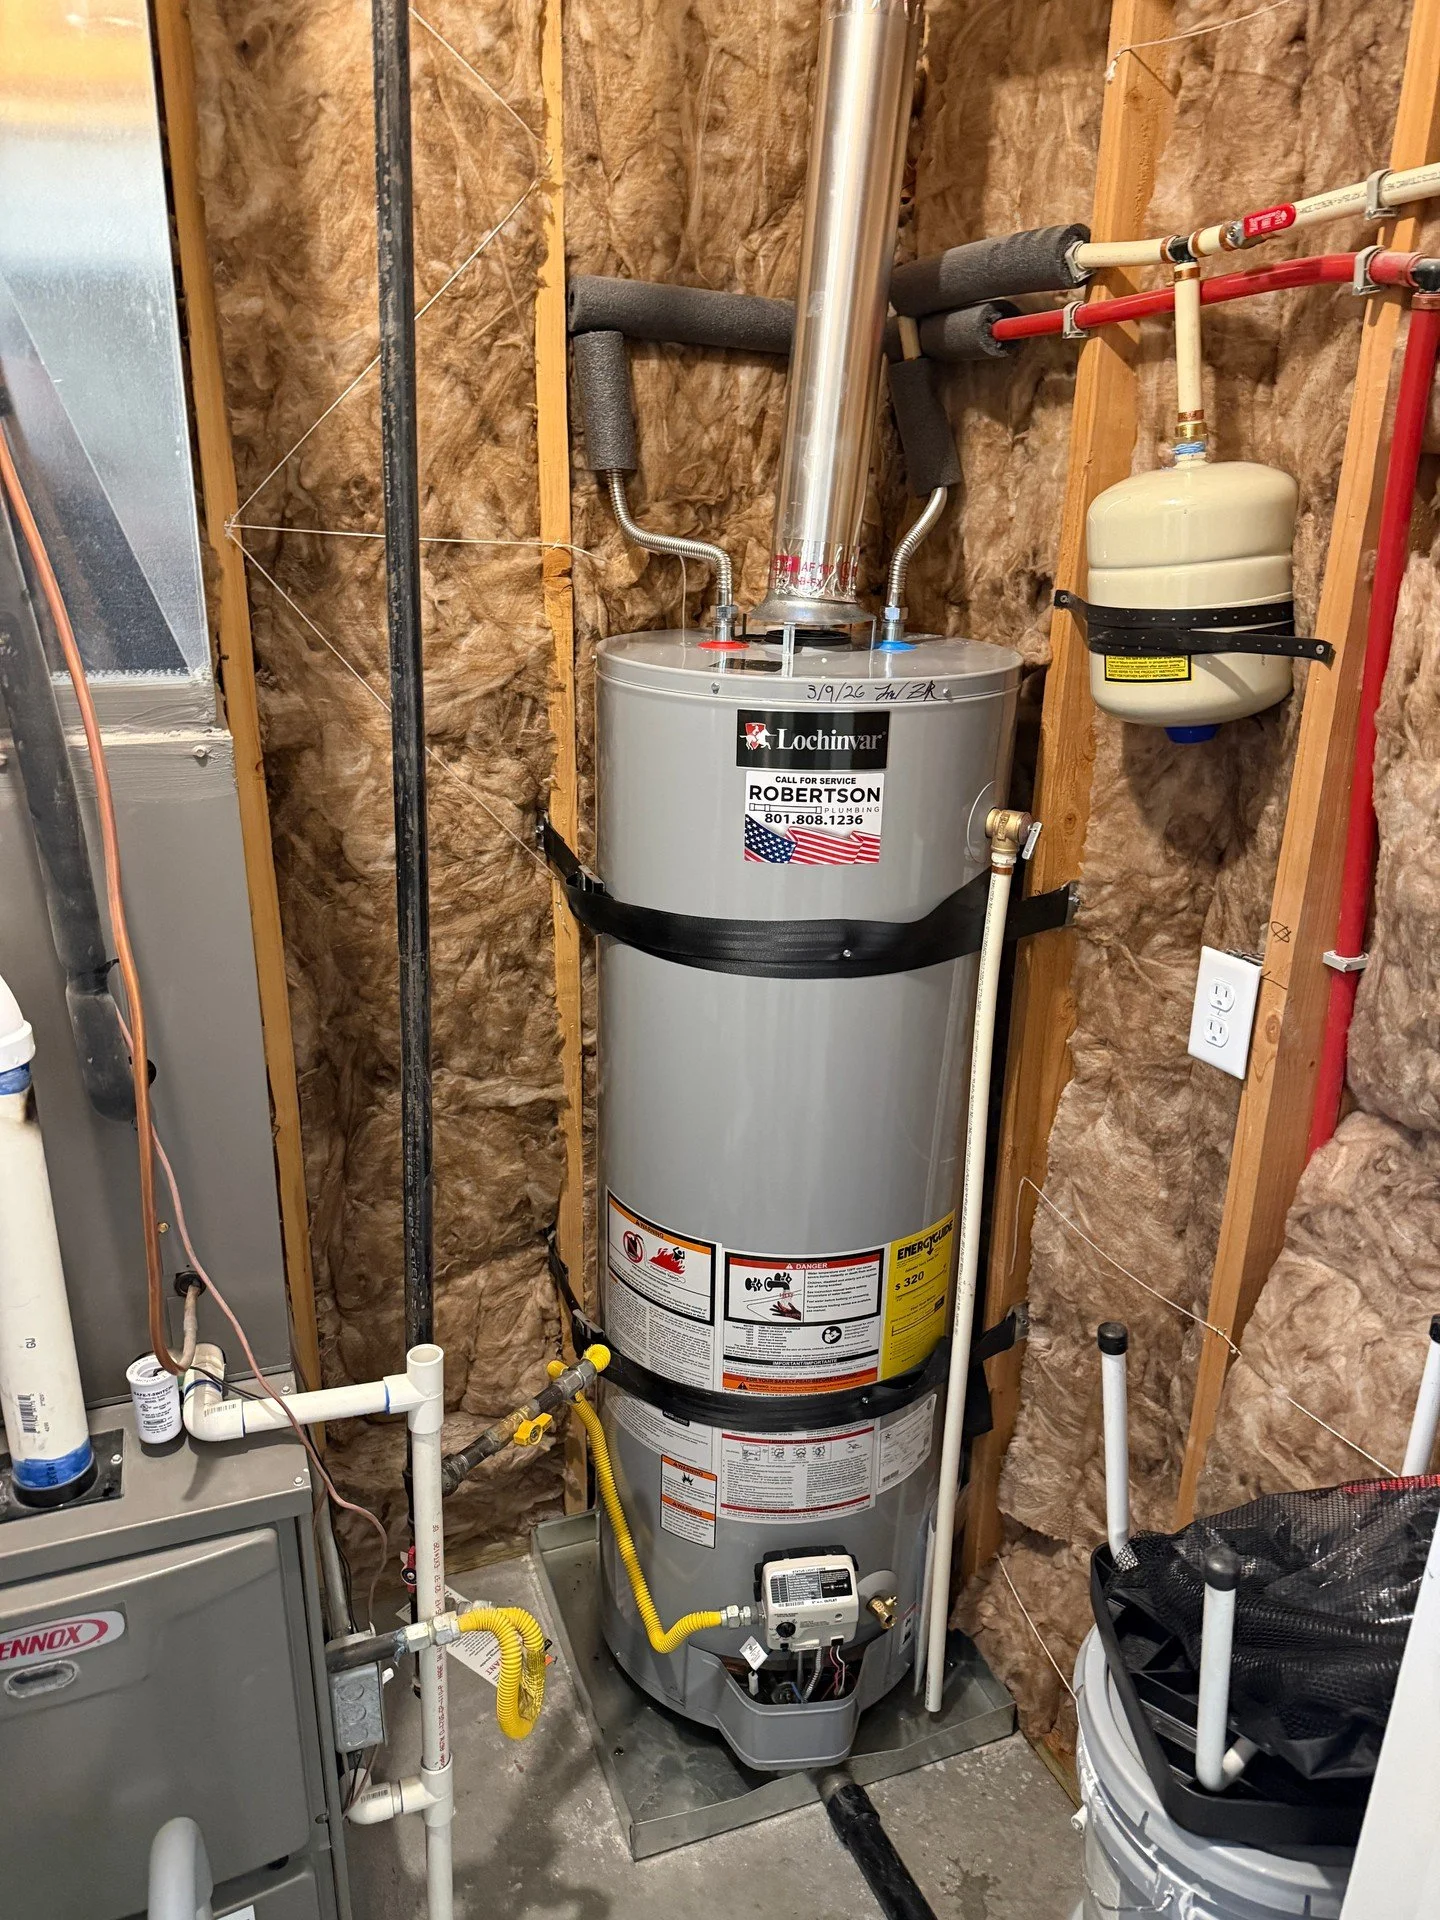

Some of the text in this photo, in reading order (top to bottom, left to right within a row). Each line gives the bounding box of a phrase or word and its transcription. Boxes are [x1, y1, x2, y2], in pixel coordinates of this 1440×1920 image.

[807, 682, 865, 702] 3/9/26
[776, 728, 880, 751] Lochinvar
[775, 776, 856, 785] CALL FOR SERVICE
[749, 785, 880, 803] ROBERTSON
[765, 813, 864, 826] 801.808.1236
[897, 1219, 954, 1260] ENERGYGUIDE
[795, 1262, 828, 1270] DANGER
[903, 1270, 925, 1288] 320
[0, 1624, 83, 1661] ENNOX
